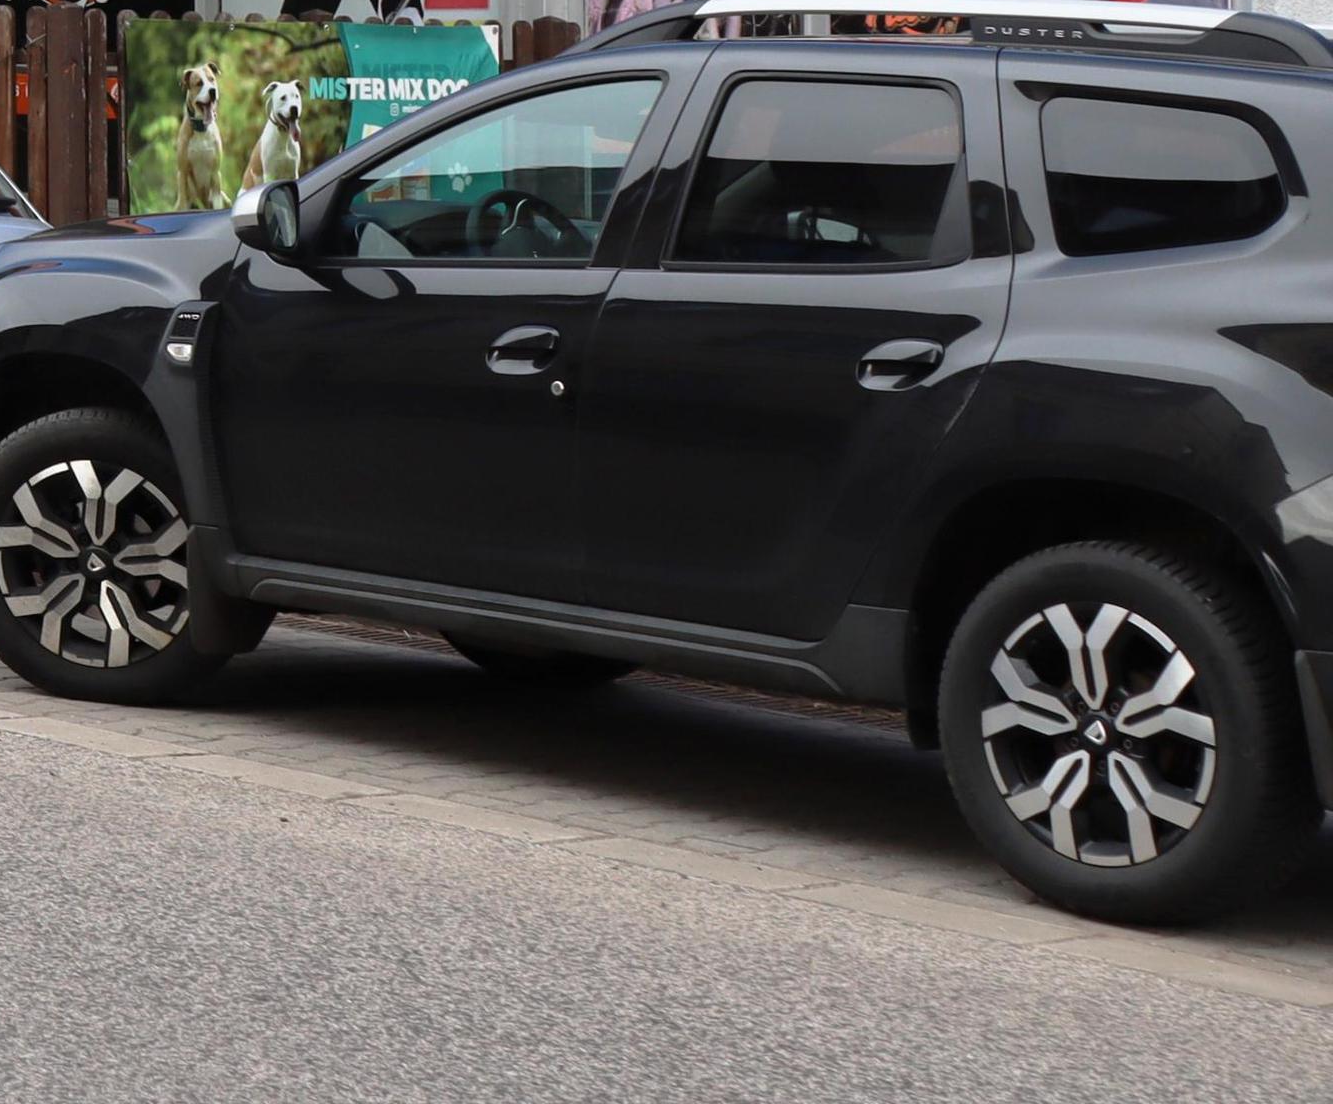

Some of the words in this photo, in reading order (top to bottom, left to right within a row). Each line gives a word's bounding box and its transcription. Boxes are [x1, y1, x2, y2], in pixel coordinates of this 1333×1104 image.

[983, 26, 1083, 39] DUSTER
[309, 77, 387, 101] MISTER
[388, 77, 426, 101] MIX
